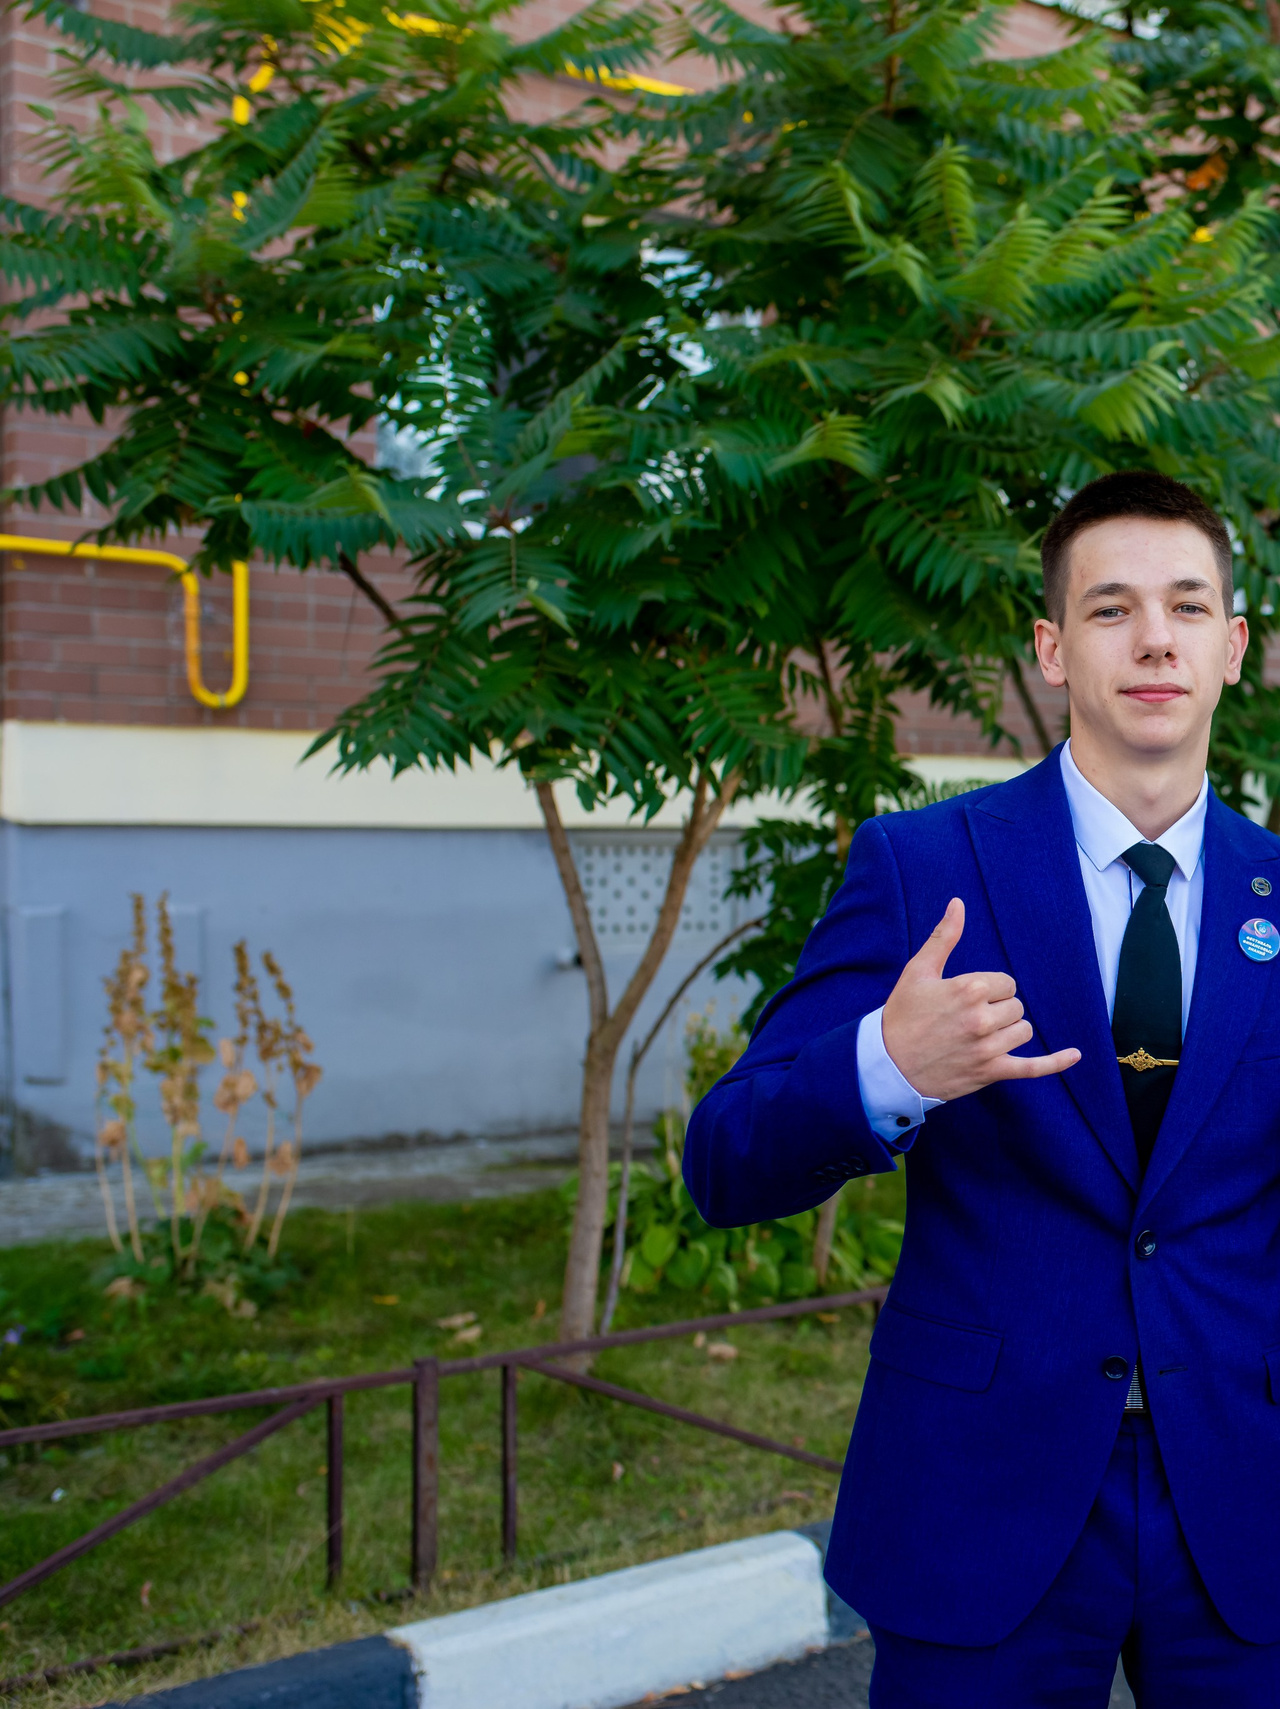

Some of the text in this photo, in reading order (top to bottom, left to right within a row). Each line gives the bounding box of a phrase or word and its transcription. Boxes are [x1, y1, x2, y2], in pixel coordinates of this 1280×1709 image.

[1242, 939, 1273, 954] ФИНАНСОВЫХ
[1246, 936, 1272, 949] ФЕСТИВАЛЬ
[1248, 946, 1266, 956] ЗНАНИЙ
